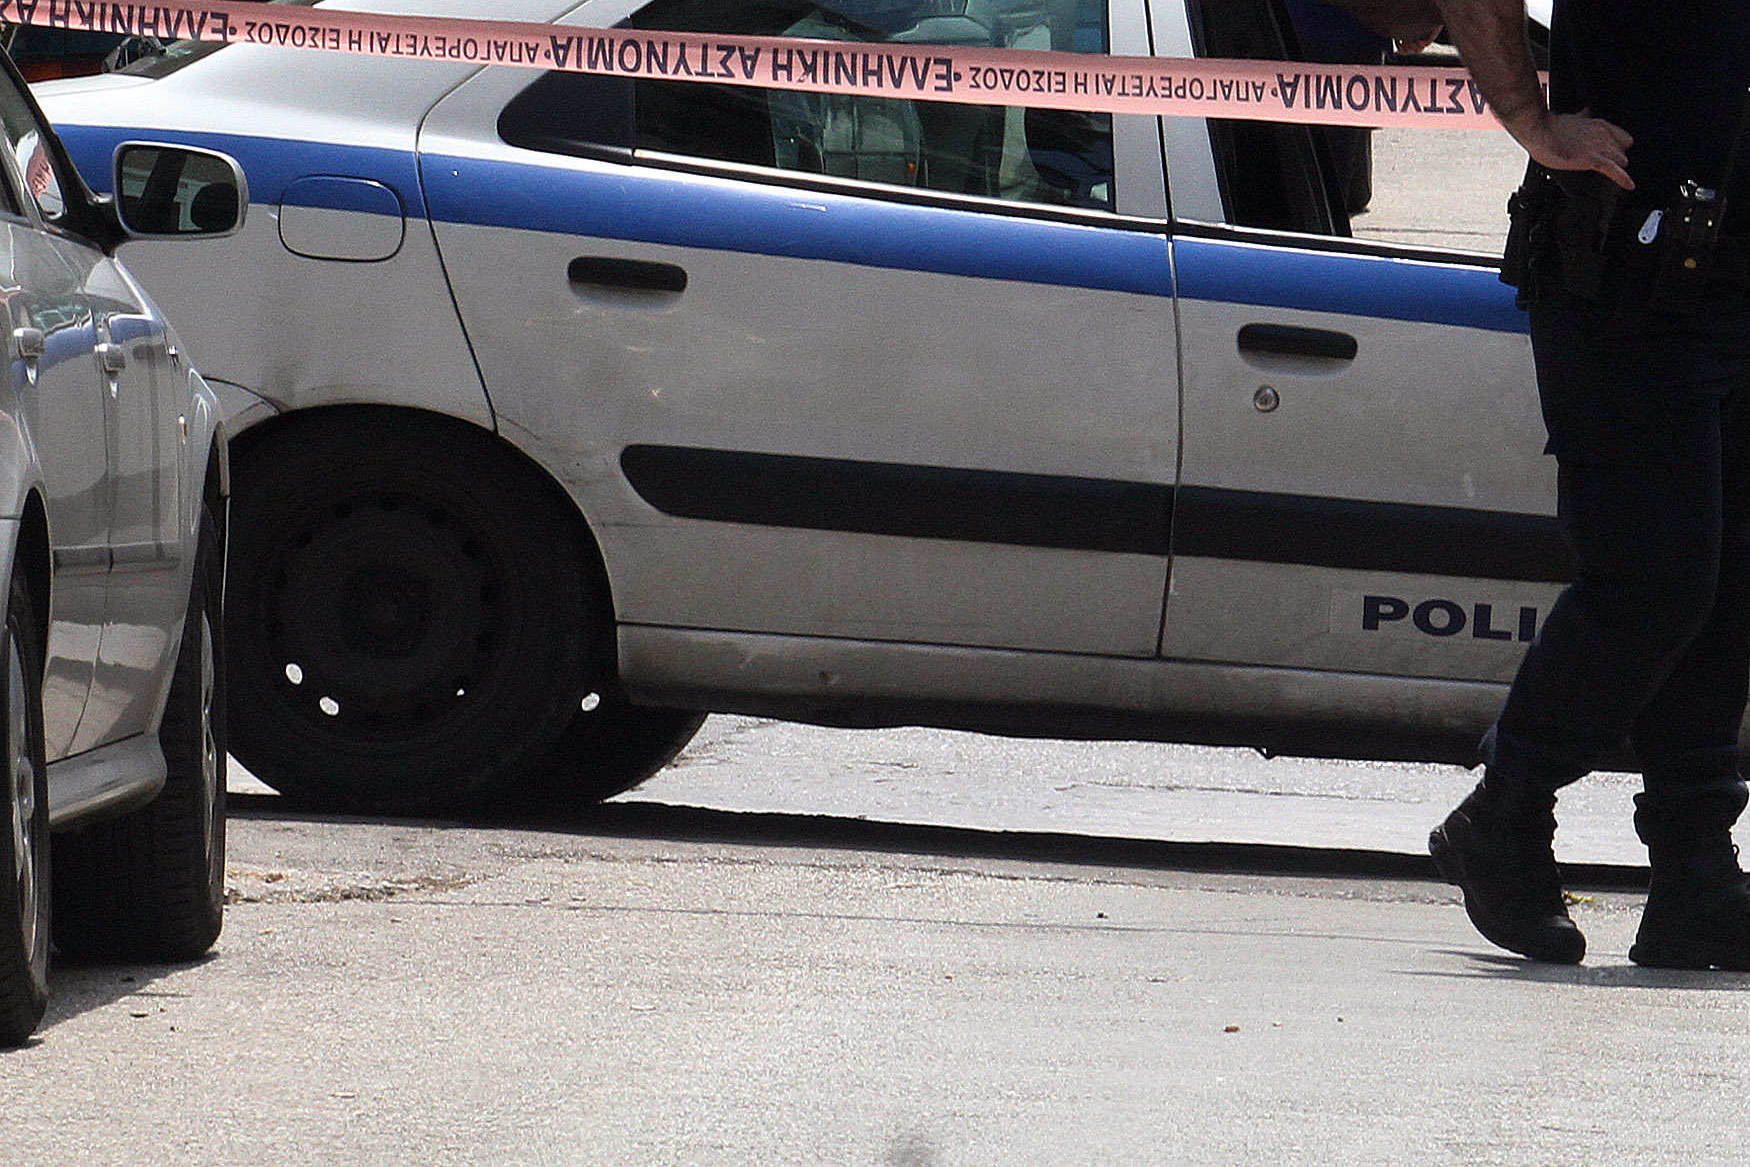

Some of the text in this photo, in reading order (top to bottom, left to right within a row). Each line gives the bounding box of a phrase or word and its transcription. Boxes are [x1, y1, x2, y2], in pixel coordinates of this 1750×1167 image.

[245, 21, 341, 50] ΕΙΣΟΔΟΣ
[349, 28, 362, 51] Η
[369, 30, 540, 64] ΑΠΑΓΟΡΕΥΕΤΑΙ
[549, 32, 762, 80] ΑΣΤΥΝΟΜΙΑ
[771, 45, 953, 92] ΕΛΛΗΝΙΚΗ
[969, 67, 1067, 93] ΕΙΣΟΔΟΣ
[1075, 72, 1088, 95] Η
[1094, 74, 1266, 103] ΑΠΑΓΟΡΕΥΕΤΑΙ
[1276, 72, 1485, 114] ΑΣΤΥΝΟΜΙΑ
[1362, 595, 1538, 643] POLI
